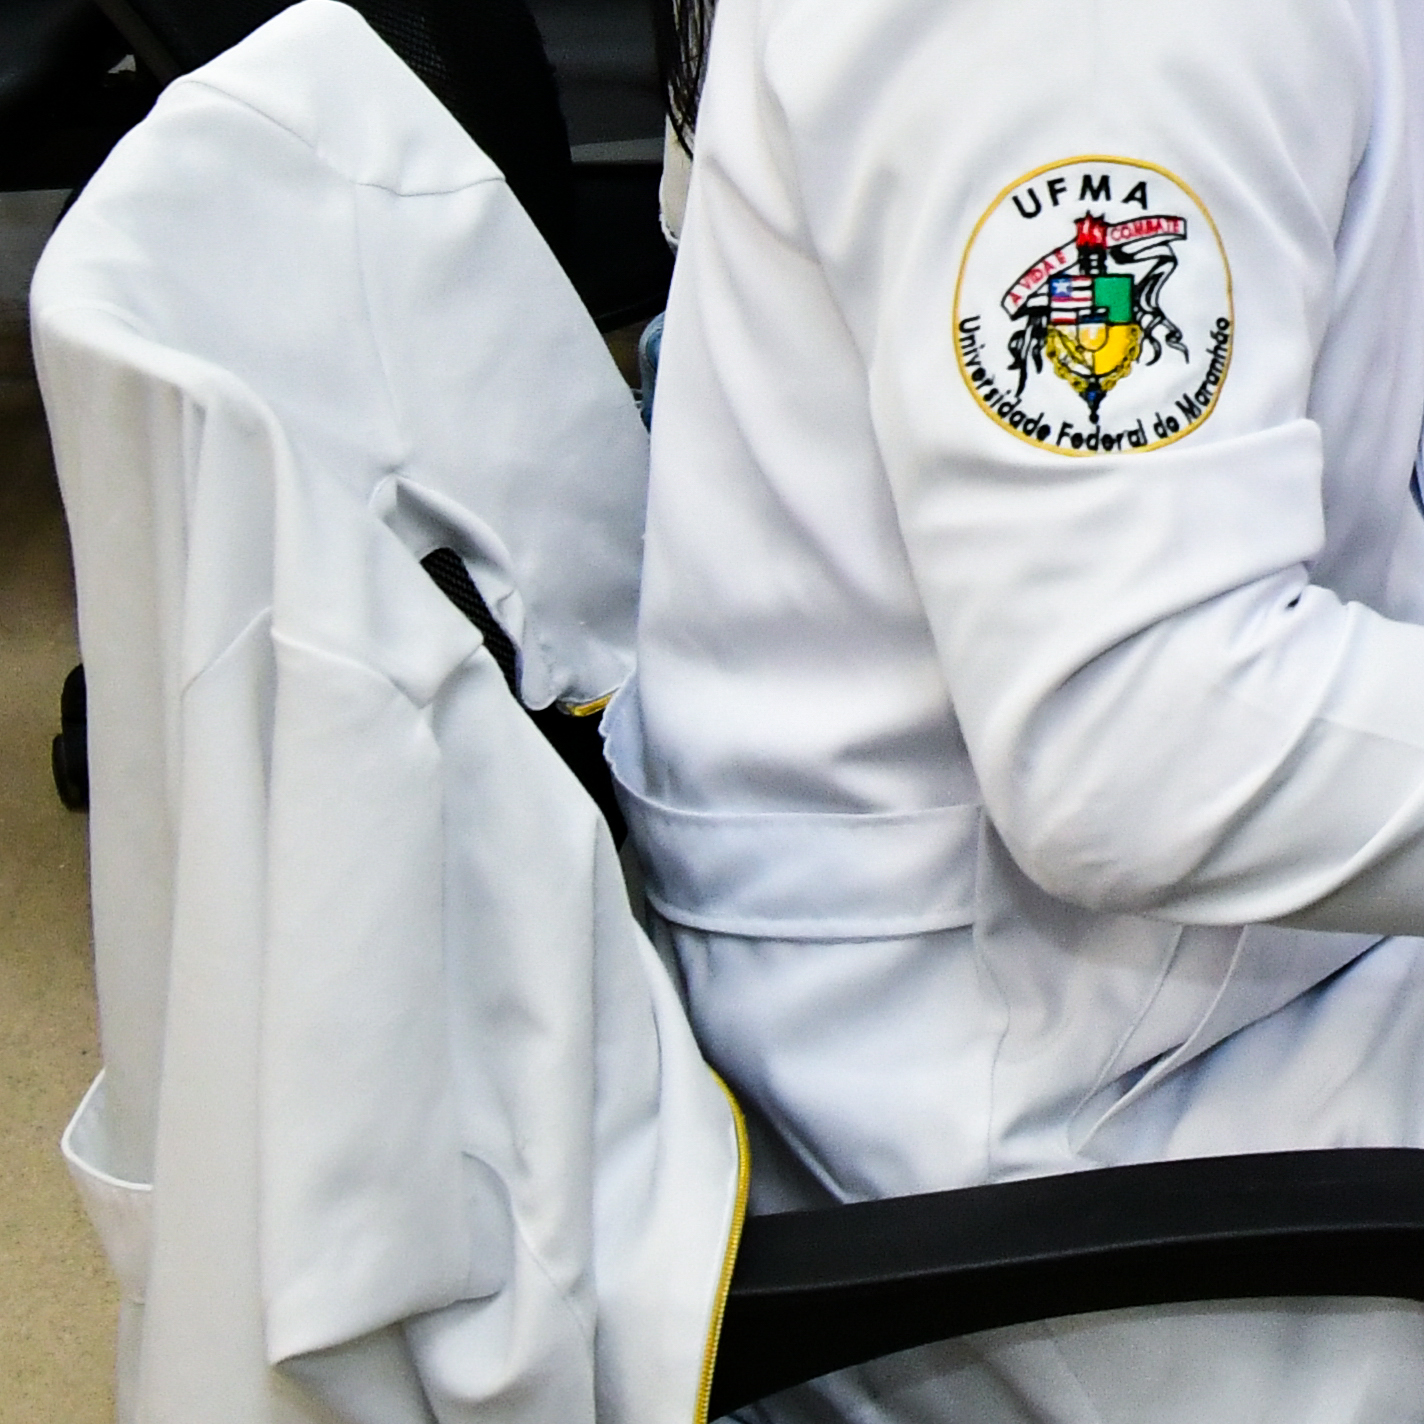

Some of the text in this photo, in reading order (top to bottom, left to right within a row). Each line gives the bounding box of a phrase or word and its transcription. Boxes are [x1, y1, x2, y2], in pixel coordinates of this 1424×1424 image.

[1011, 173, 1149, 219] UFMA
[958, 315, 1052, 442] Universidade
[1055, 417, 1149, 452] Federal
[1153, 411, 1181, 440] do
